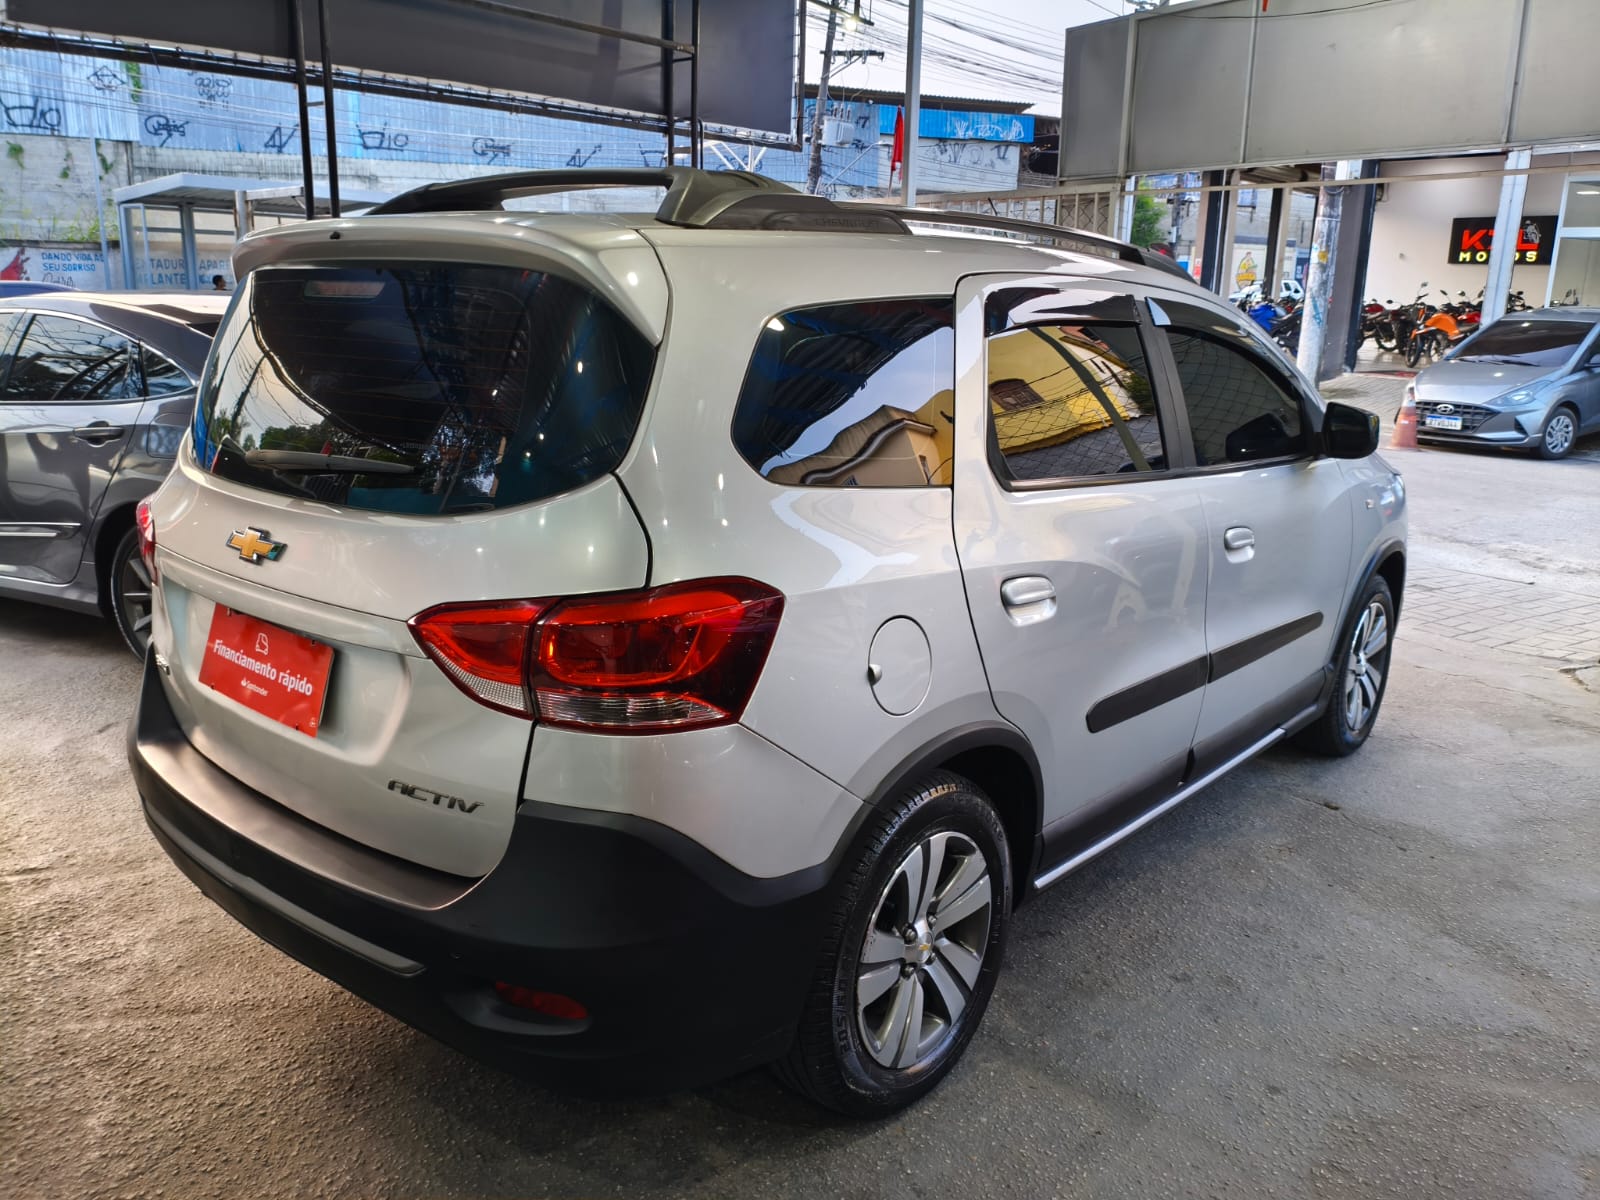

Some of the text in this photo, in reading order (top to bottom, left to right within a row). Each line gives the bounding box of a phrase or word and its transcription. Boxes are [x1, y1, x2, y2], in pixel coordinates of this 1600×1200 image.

[41, 252, 72, 261] DANDO
[75, 253, 93, 261] VIDA
[1458, 251, 1537, 262] MOS
[43, 263, 96, 272] SEU SORRISO
[213, 639, 313, 696] Financiamento rápido
[387, 779, 485, 814] ACTIV
